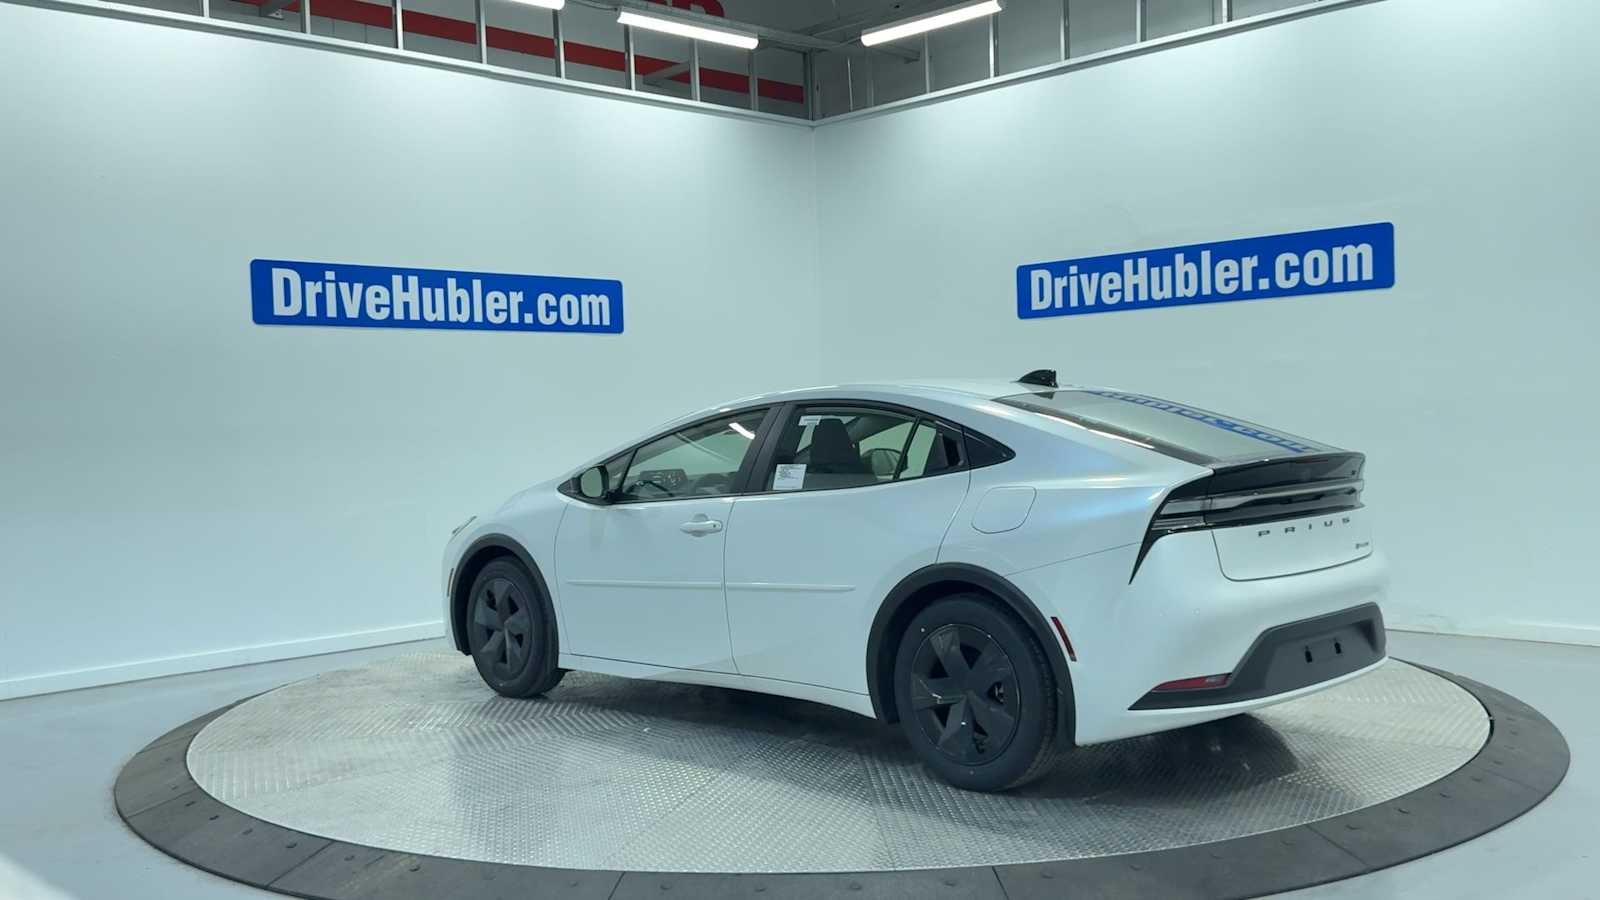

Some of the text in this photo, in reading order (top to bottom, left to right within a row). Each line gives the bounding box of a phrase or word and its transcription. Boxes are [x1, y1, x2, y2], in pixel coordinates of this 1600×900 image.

[271, 268, 611, 325] DriveHubler.com
[1031, 242, 1373, 310] DriveHubler.com
[1258, 518, 1350, 537] PRIUS
